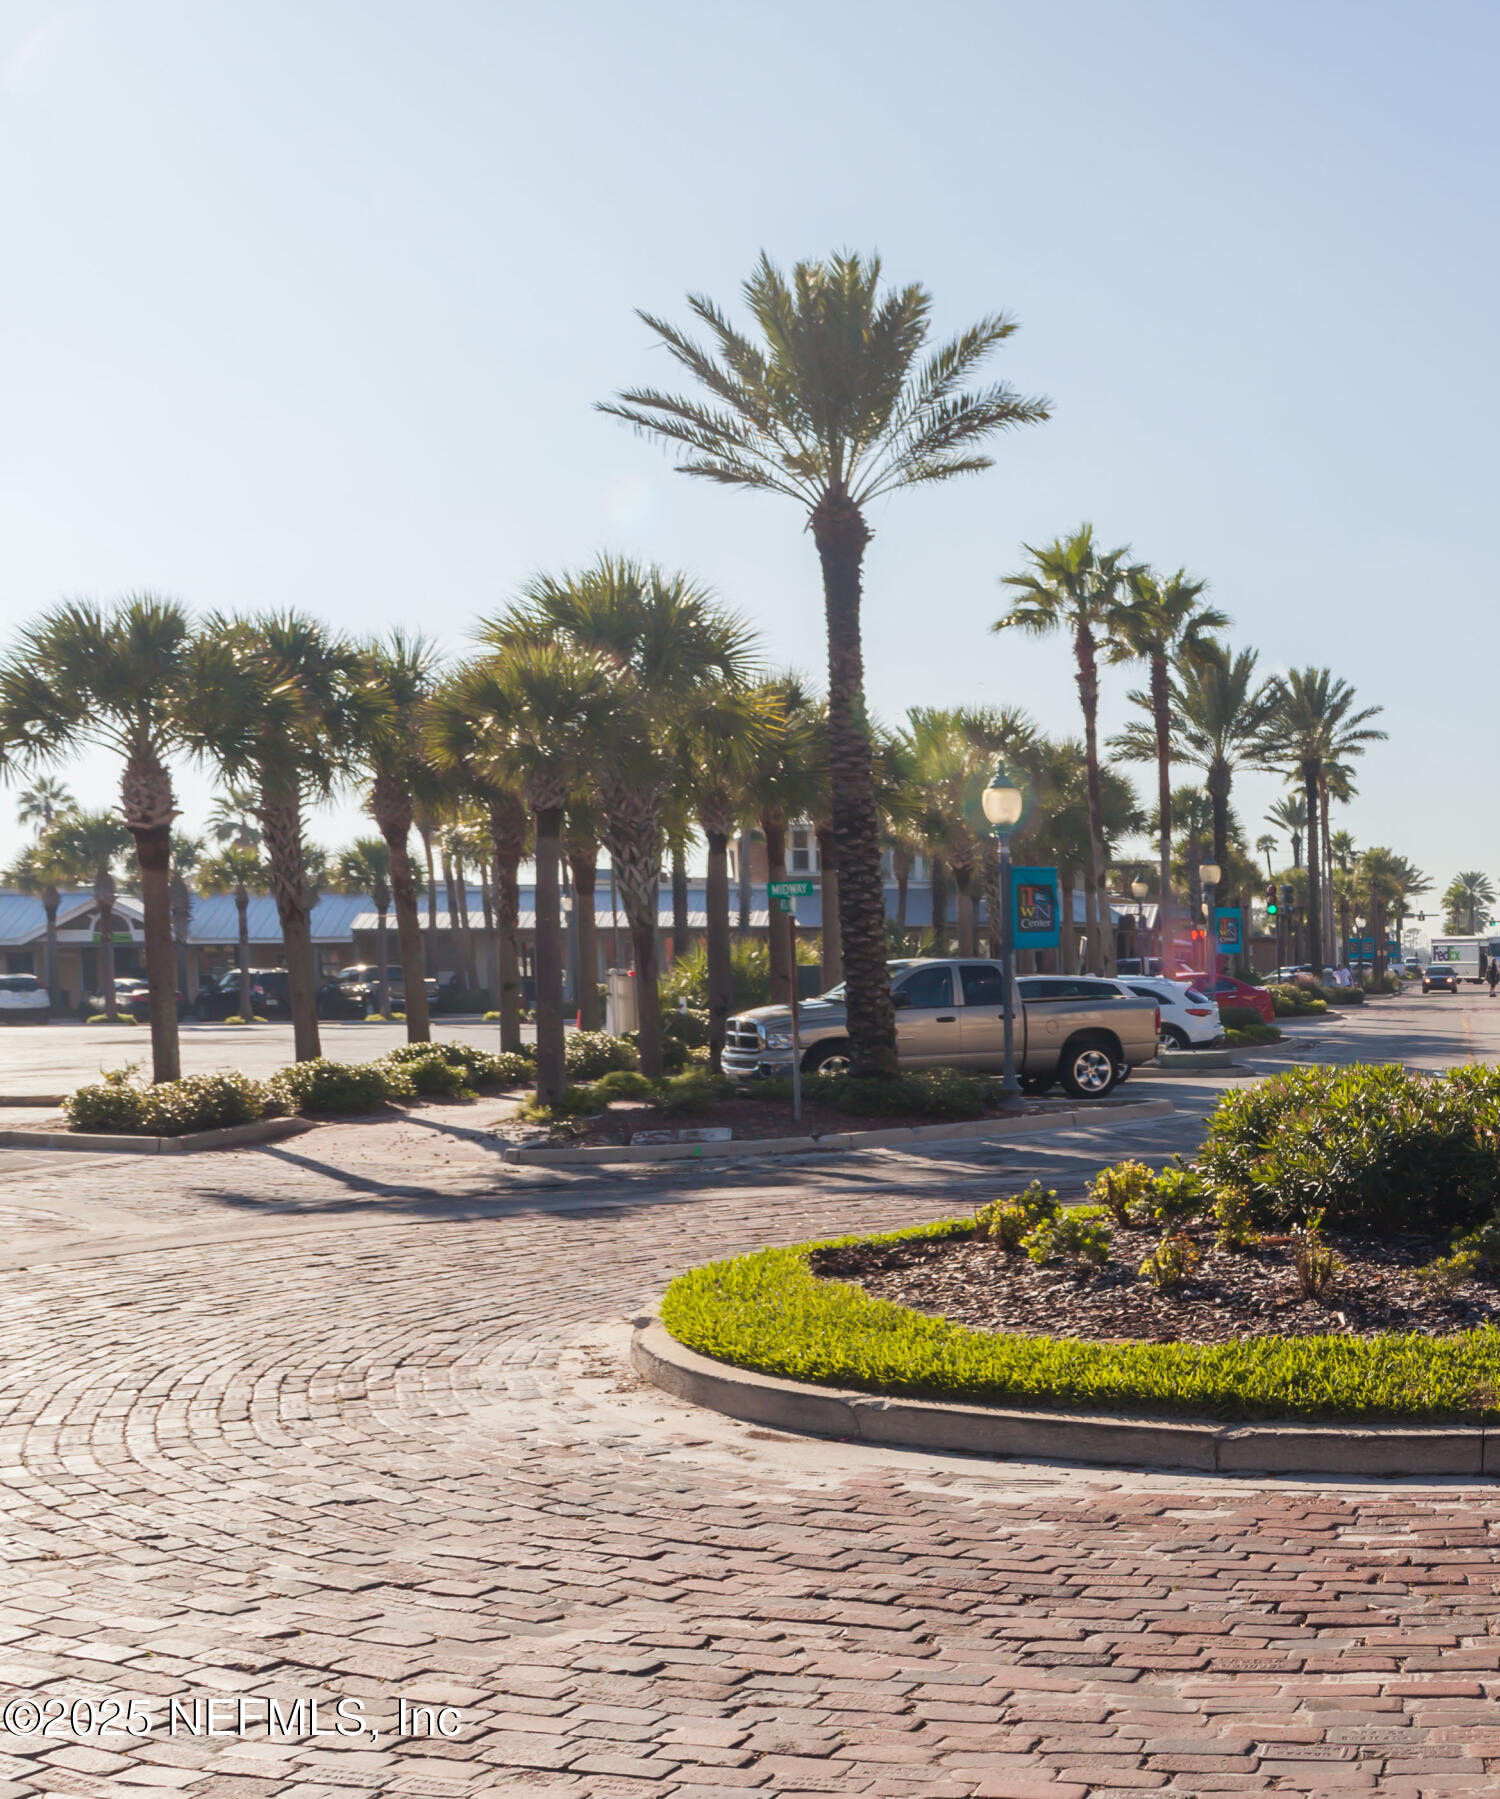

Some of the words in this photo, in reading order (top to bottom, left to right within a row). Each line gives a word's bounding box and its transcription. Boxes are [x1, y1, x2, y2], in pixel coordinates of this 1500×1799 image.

[771, 883, 807, 895] MIDWAY
[1020, 918, 1052, 929] Center
[1432, 945, 1461, 961] FedEx
